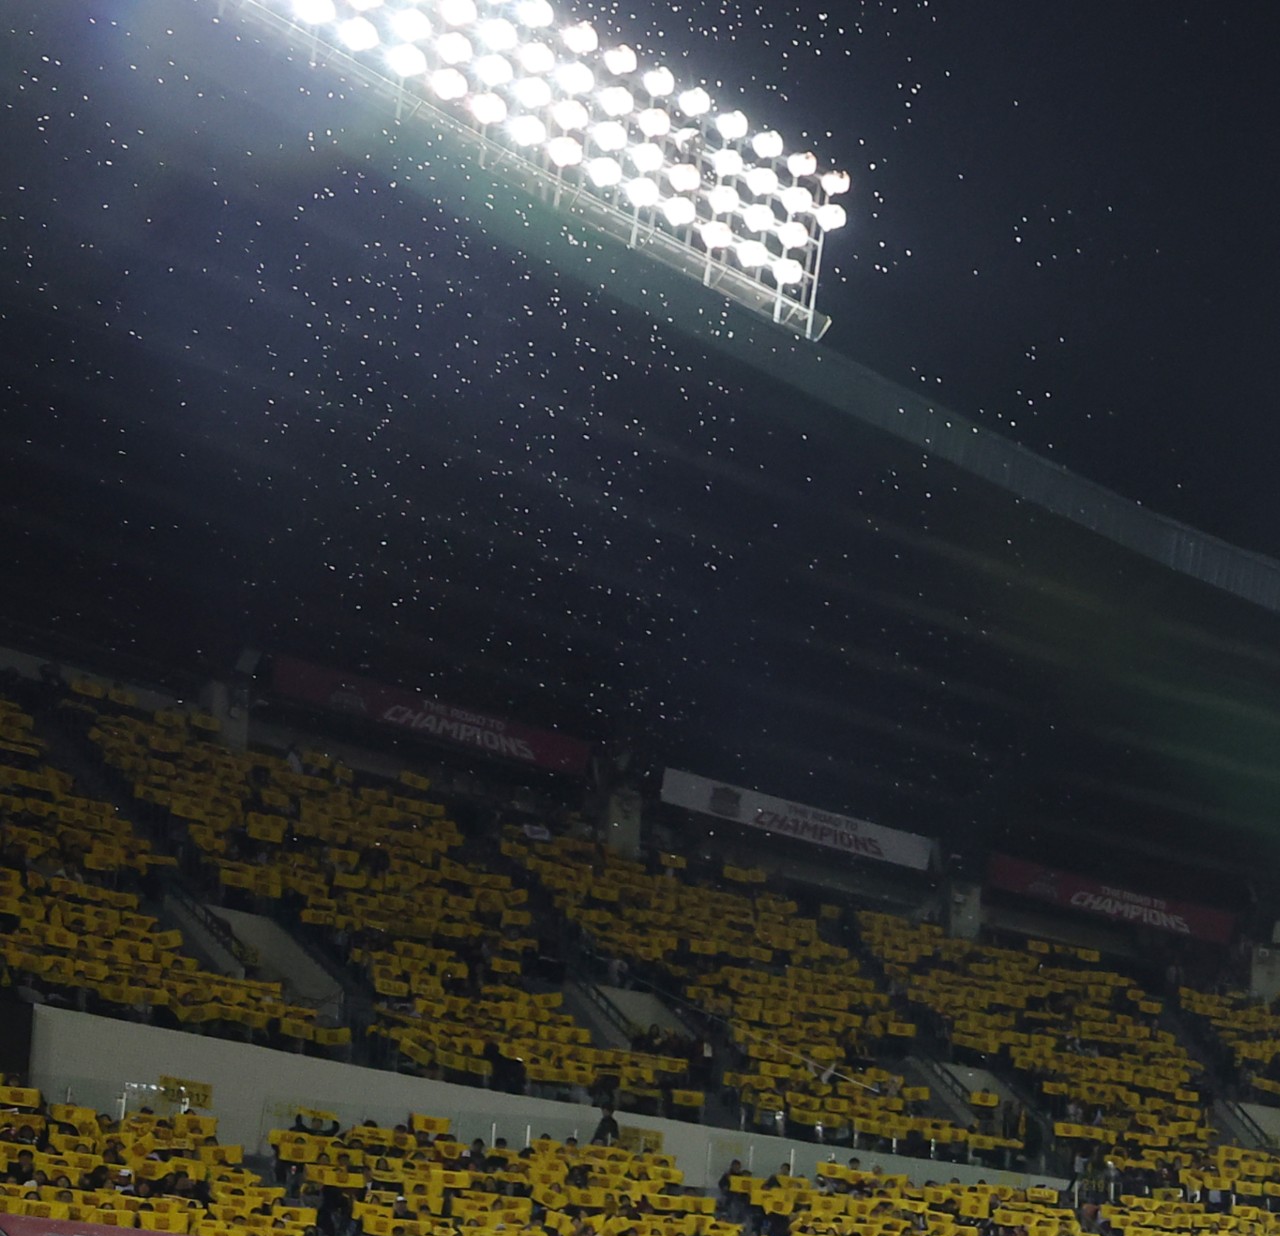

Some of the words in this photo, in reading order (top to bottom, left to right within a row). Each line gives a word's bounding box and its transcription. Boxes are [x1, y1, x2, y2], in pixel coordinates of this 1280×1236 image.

[382, 704, 535, 761] CHAMPIONS
[753, 811, 884, 857] CHAMPIONS
[1070, 890, 1190, 934] CHAMPIONS
